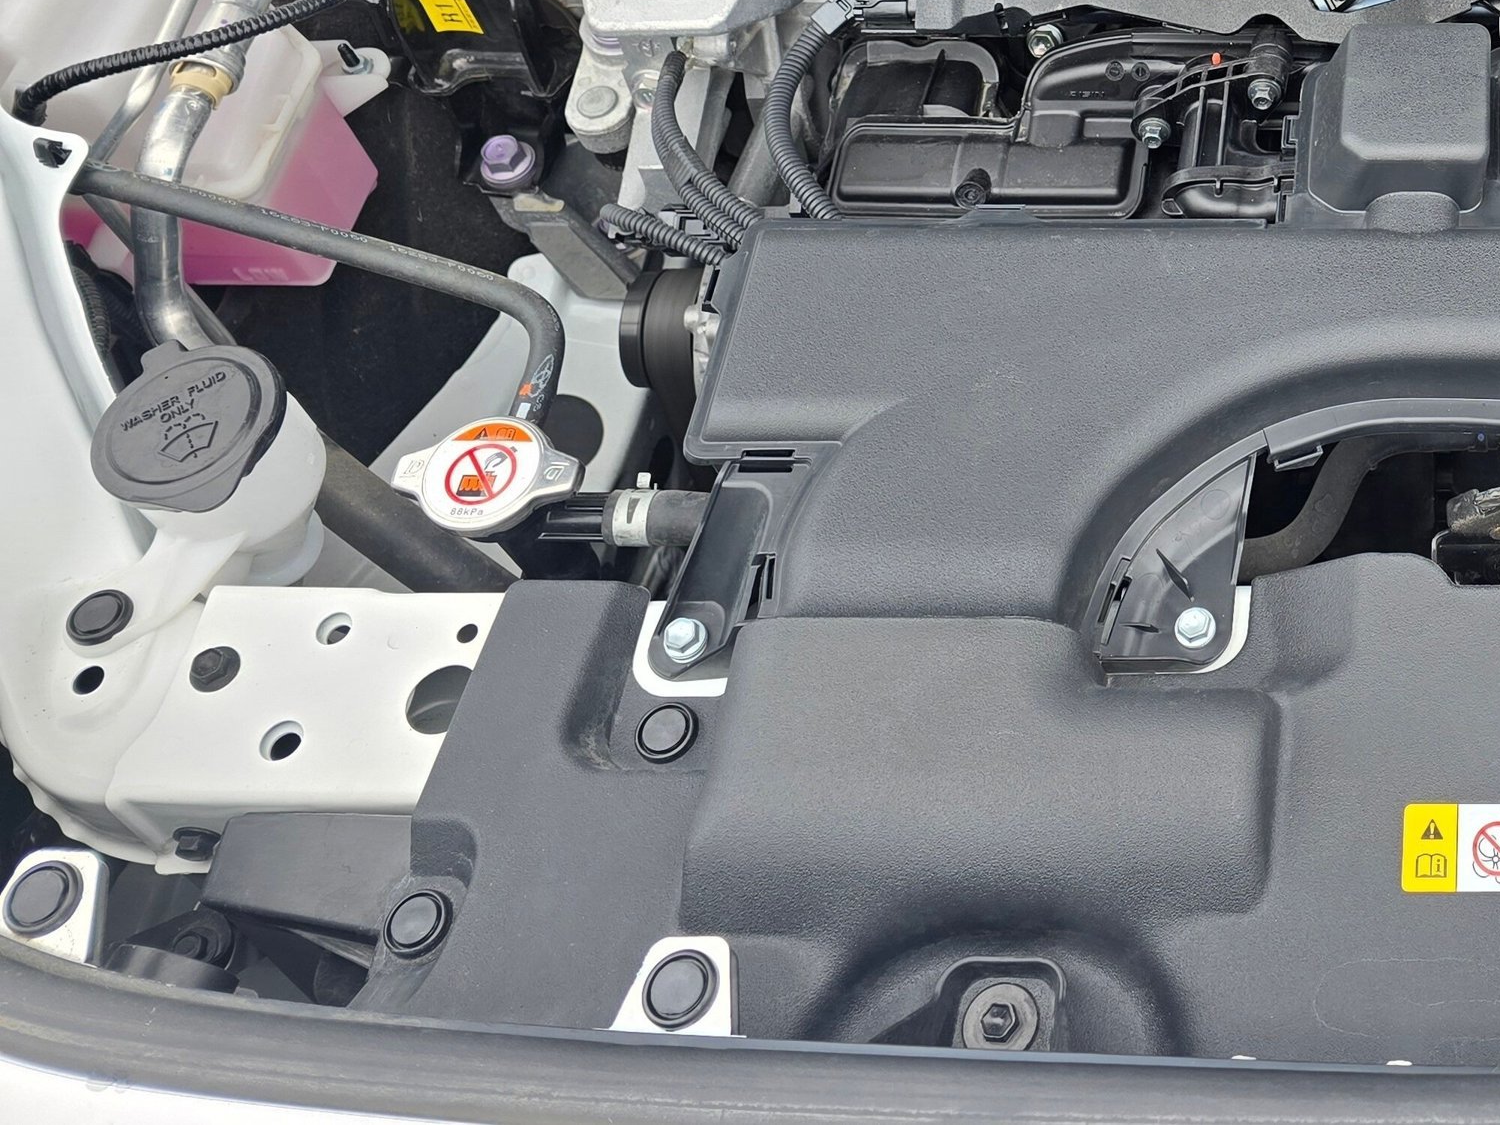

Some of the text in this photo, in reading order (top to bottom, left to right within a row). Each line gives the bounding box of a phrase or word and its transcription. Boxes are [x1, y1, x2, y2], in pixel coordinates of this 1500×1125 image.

[120, 371, 227, 432] WASHER FLUID
[160, 398, 195, 423] ONLY
[450, 507, 484, 516] 88kPa
